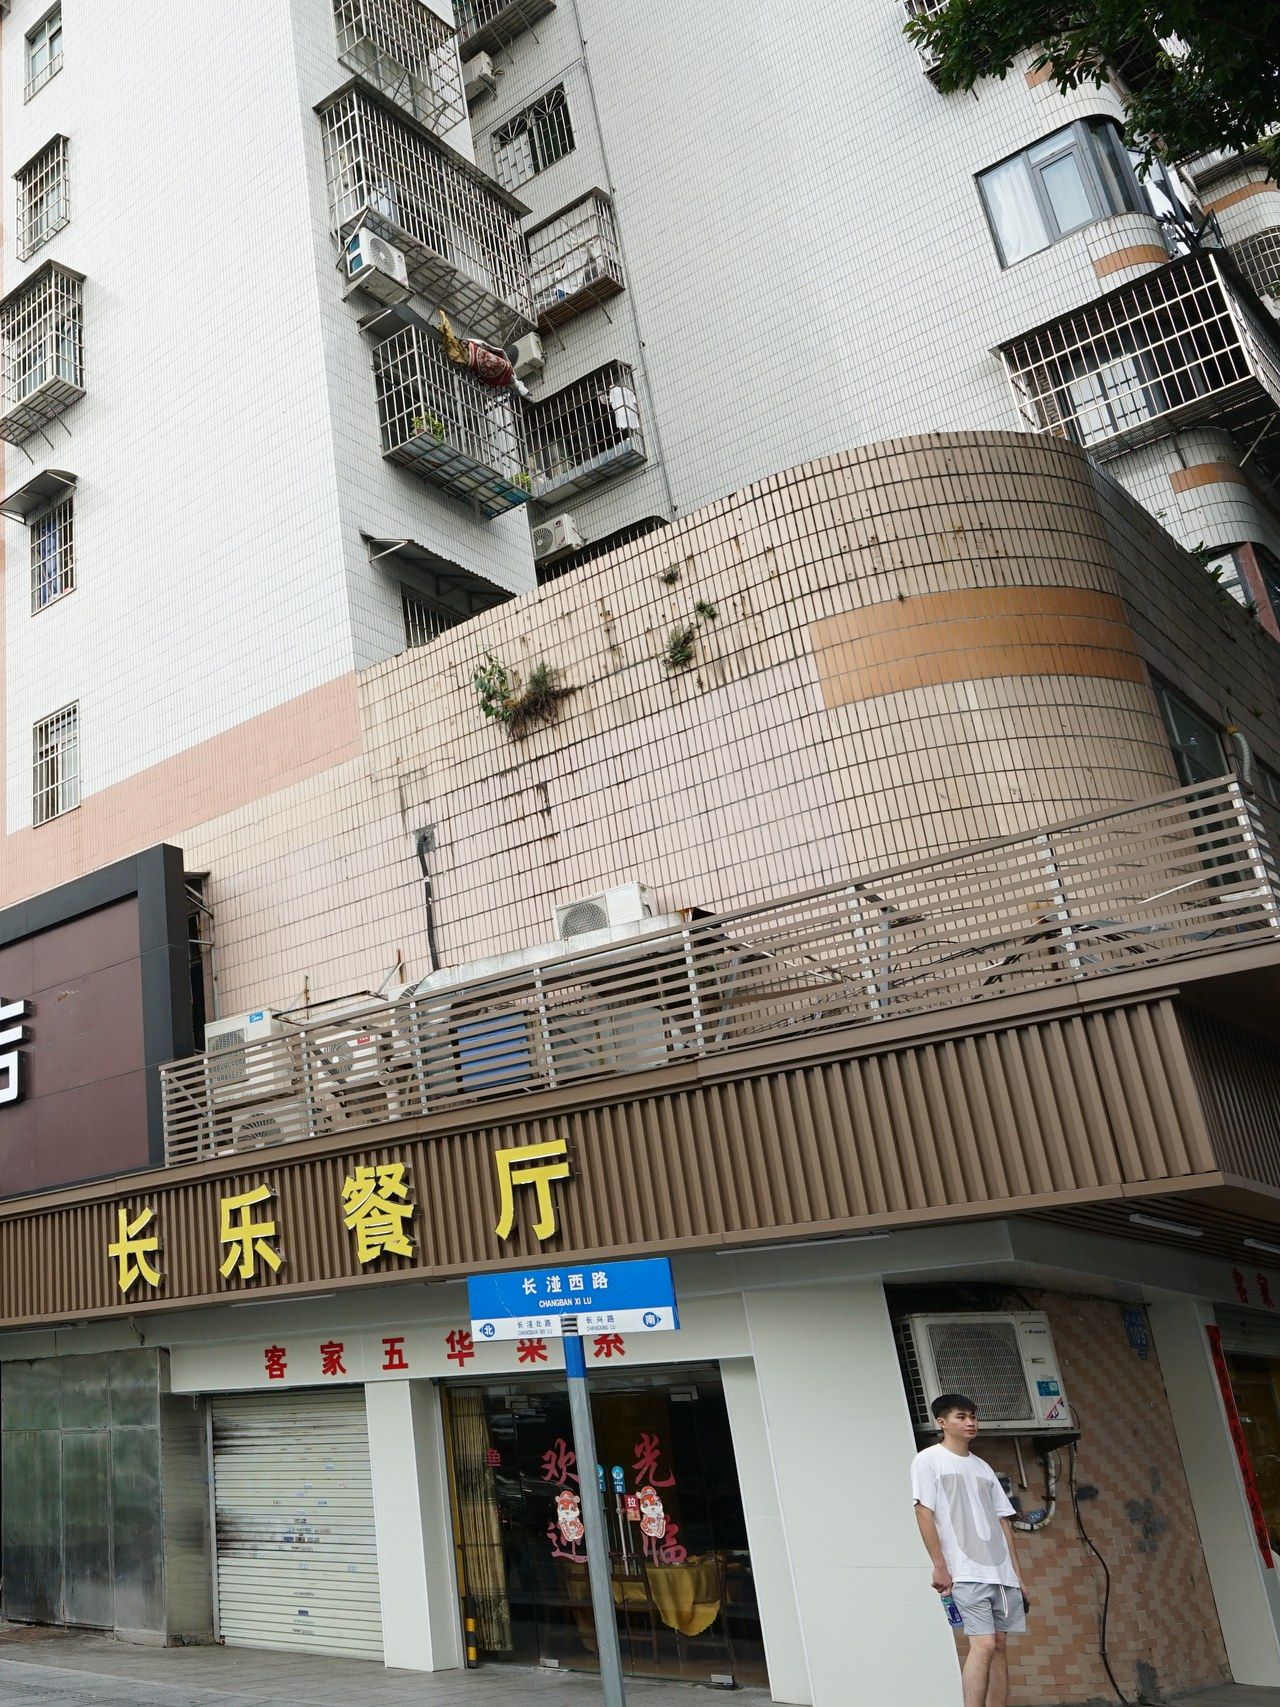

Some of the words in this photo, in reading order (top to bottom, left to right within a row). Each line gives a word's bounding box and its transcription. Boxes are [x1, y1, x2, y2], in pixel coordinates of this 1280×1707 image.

[108, 1138, 573, 1294] 长乐餐厅
[521, 1271, 609, 1295] 长湴西路
[538, 1298, 573, 1309] CHANGBAN
[574, 1297, 582, 1306] XI
[583, 1296, 592, 1305] LU
[517, 1318, 552, 1329] 长湴北路
[585, 1314, 615, 1324] 长兴路
[646, 1313, 656, 1326] 南
[484, 1325, 494, 1337] 北
[264, 1328, 626, 1380] 客家五华菜系
[627, 1496, 637, 1507] 拉
